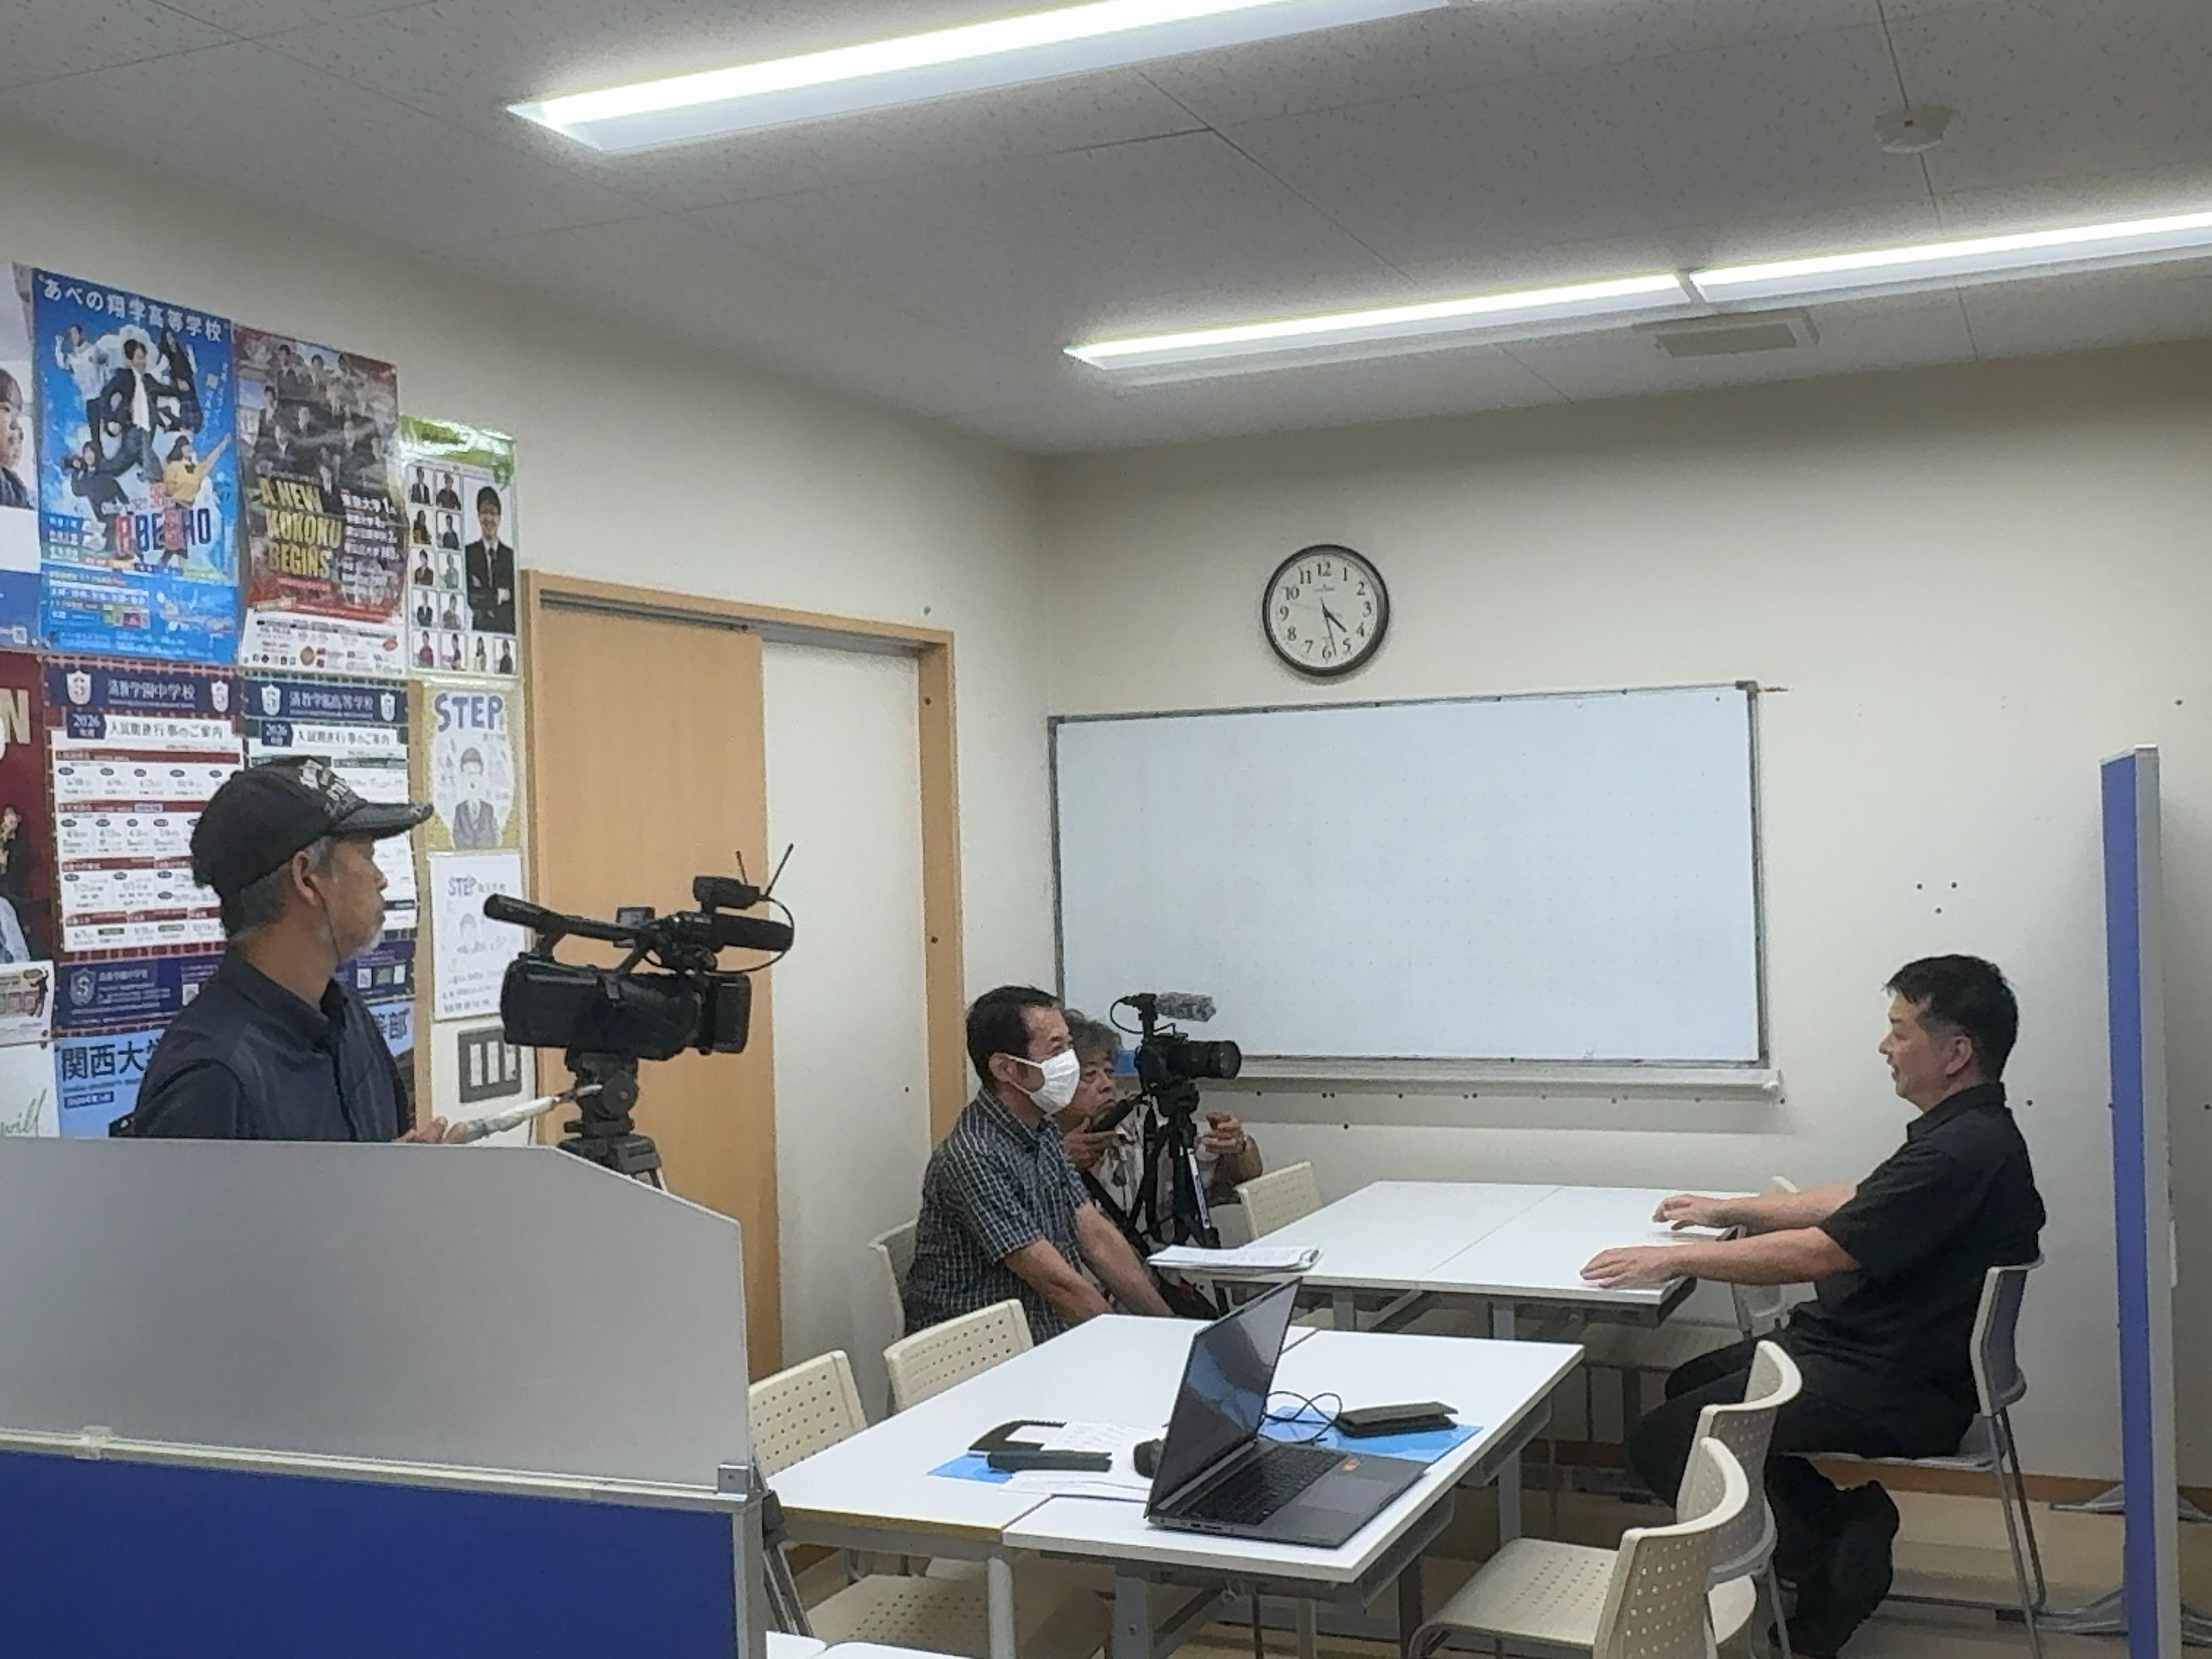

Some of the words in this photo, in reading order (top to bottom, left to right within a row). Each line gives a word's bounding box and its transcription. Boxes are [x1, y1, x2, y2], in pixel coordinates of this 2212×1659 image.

[44, 279, 222, 342] あべの翔学高等学校
[268, 543, 332, 579] BEGINS
[1298, 566, 1312, 584] 11
[1317, 562, 1331, 577] 12
[1343, 567, 1347, 581] 1
[1282, 586, 1300, 600] 10
[1357, 581, 1366, 596] 2
[1279, 606, 1289, 622] 9
[1362, 601, 1372, 617] 3
[1288, 626, 1296, 641] 8
[1356, 621, 1365, 637] 4
[1305, 639, 1313, 655] 7
[1322, 644, 1332, 659] 6
[1343, 638, 1351, 651] 5
[434, 693, 503, 732] STEP
